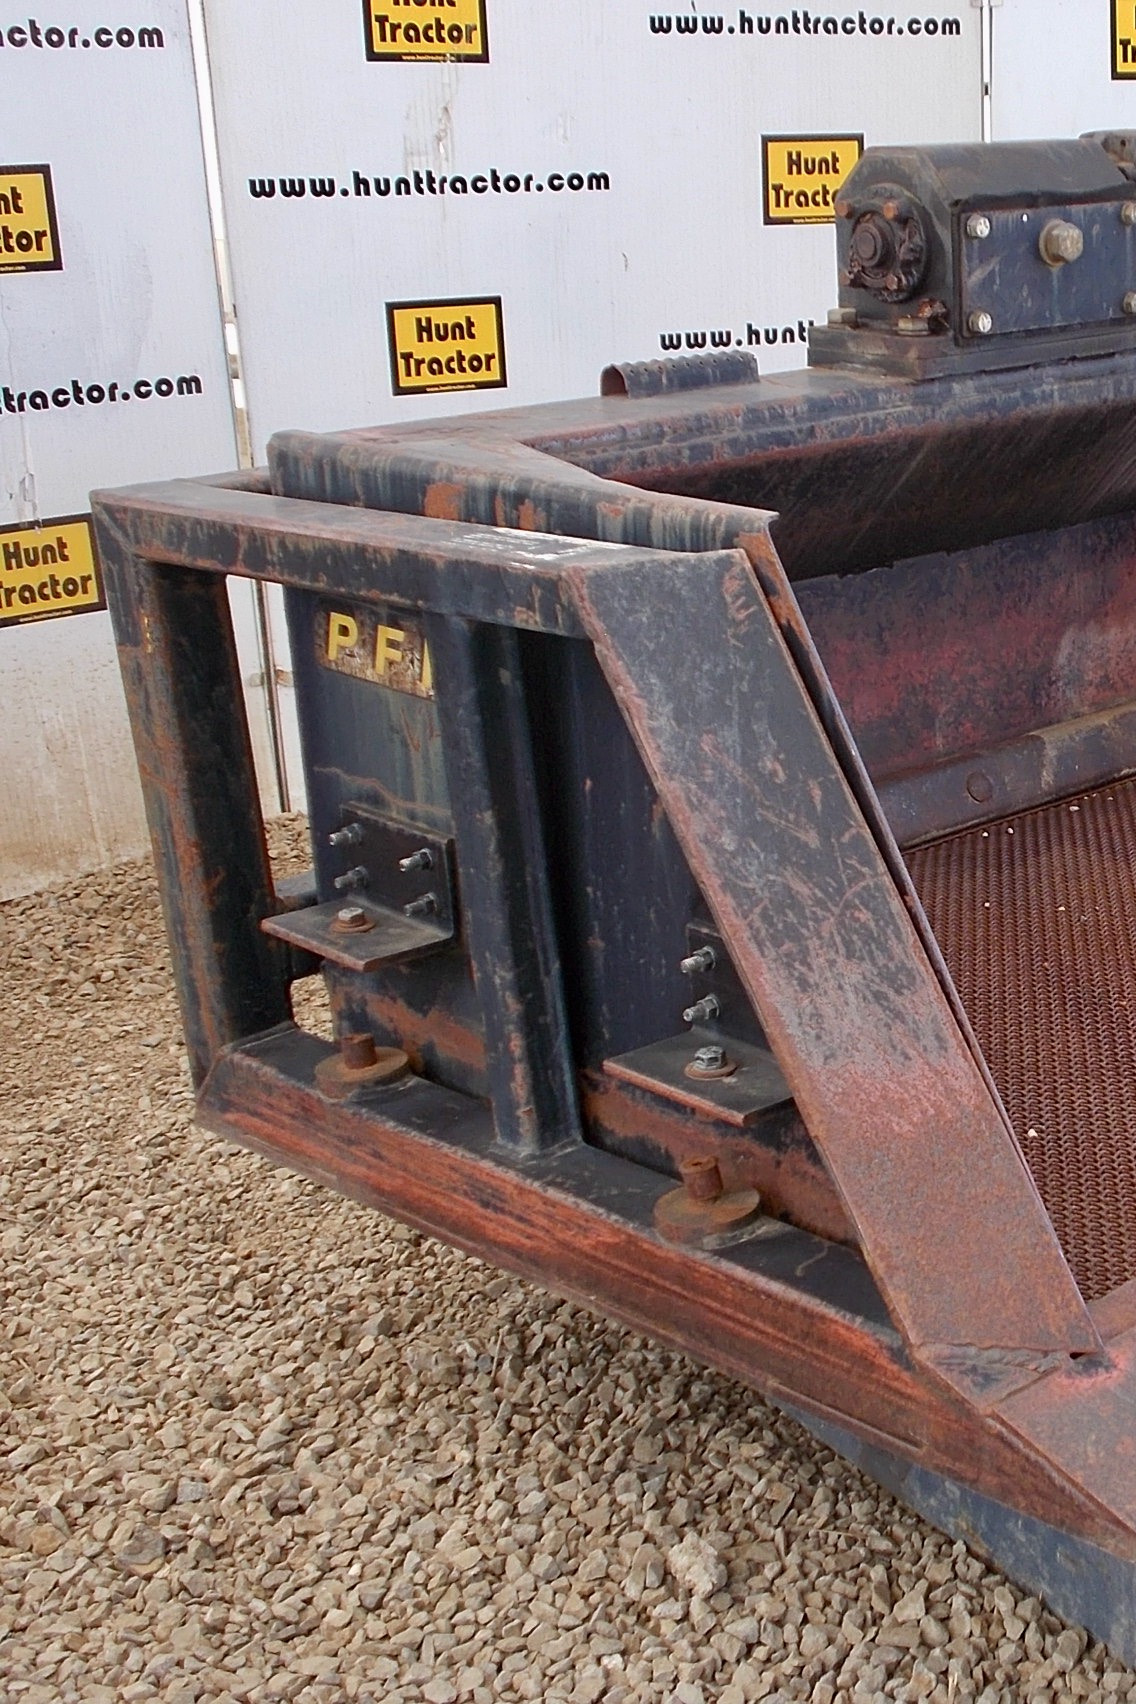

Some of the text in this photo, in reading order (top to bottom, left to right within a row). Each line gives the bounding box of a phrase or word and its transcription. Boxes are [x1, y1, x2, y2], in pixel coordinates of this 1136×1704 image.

[0, 18, 165, 48] ctor.com
[374, 14, 478, 44] Tractor
[649, 9, 961, 35] www.hunttractor.com
[786, 150, 840, 175] Hunt
[248, 168, 611, 199] www.hunttractor.com
[0, 225, 48, 254] tor
[415, 315, 476, 343] Hunt
[400, 349, 496, 378] Tractor
[0, 374, 203, 415] tractor.com
[2, 536, 70, 571] Hunt
